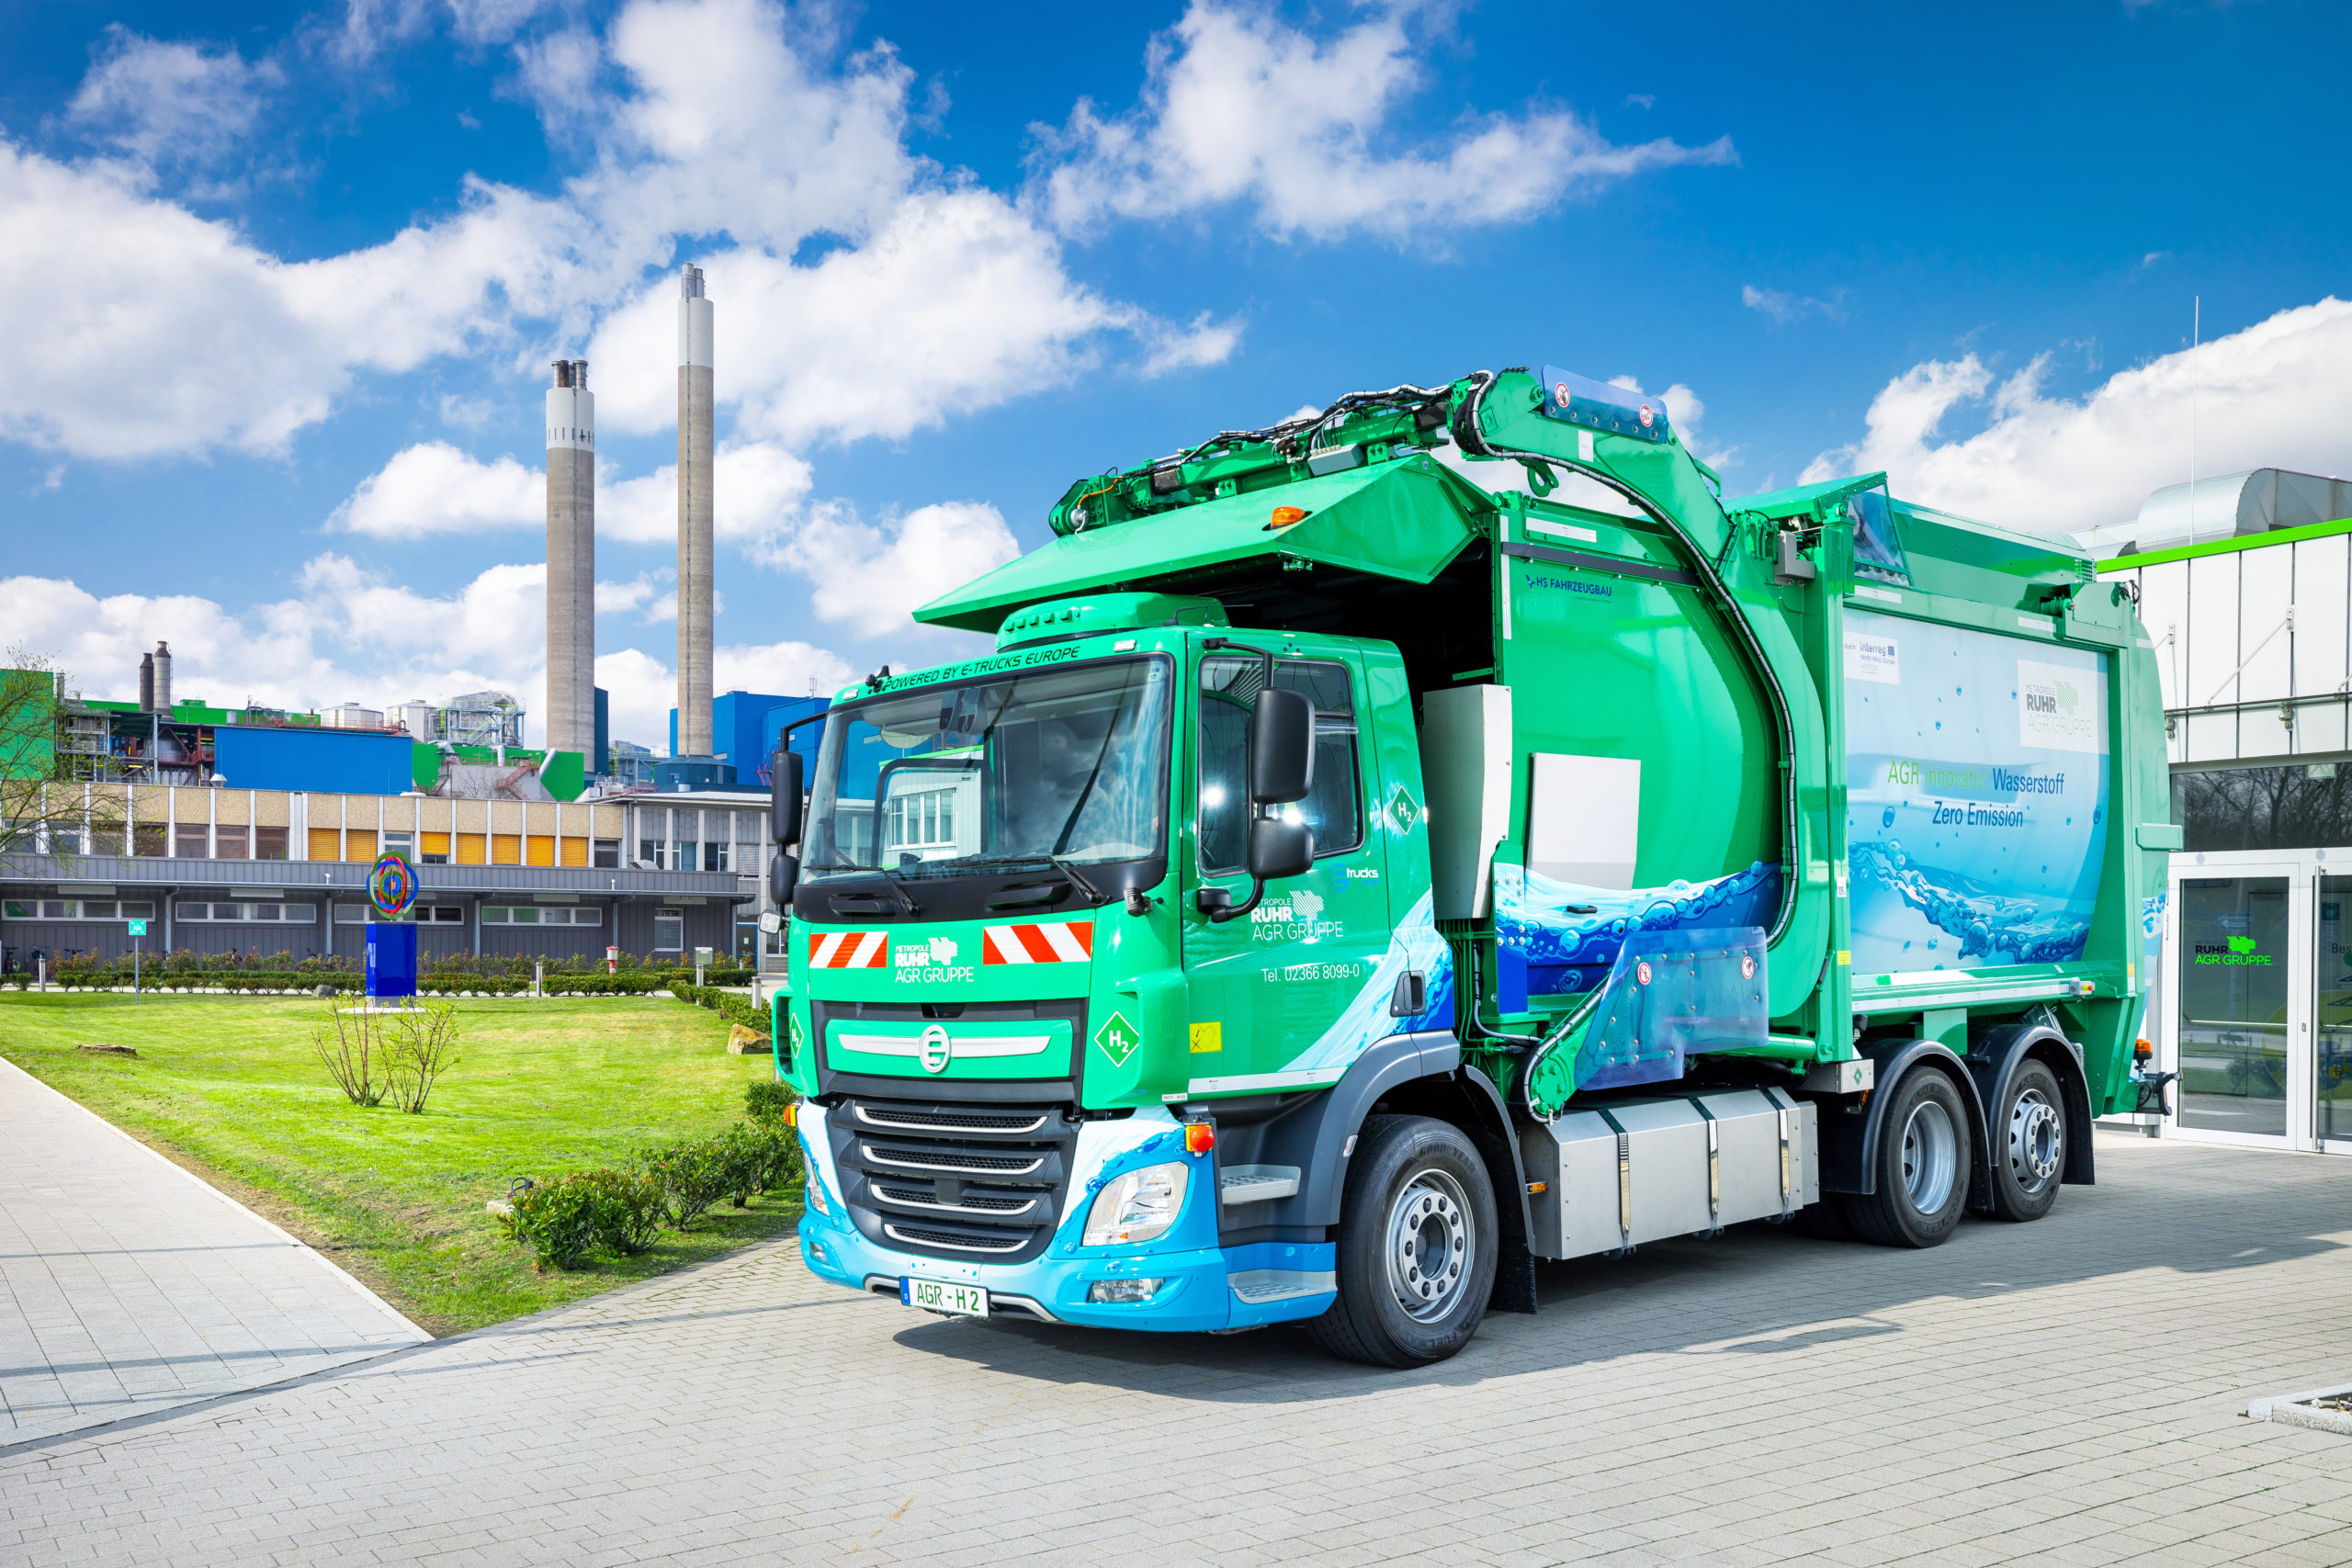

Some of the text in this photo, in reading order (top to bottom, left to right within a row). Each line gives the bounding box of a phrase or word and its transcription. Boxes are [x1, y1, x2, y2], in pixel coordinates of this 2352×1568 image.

[1536, 576, 1612, 596] HS FAHRZEUGBAU
[1860, 640, 1886, 656] Interreg
[883, 646, 1080, 692] POWERED BY E-TRUCKS EUROPE
[2027, 694, 2057, 714] RUHR
[2028, 713, 2093, 738] AGR GRUPPE
[1887, 760, 2065, 795] AGR innovativ: Wasserstoff
[1932, 800, 2024, 828] Zero Emission
[1347, 867, 1379, 878] trucks
[1257, 897, 1291, 906] TROPOLE
[1250, 906, 1294, 923] RUHR
[1252, 921, 1344, 941] AGR GRUPPE
[895, 944, 930, 953] METROPOLE
[2195, 945, 2229, 954] RUHR
[895, 952, 930, 967] RUHR
[2195, 954, 2272, 966] AGR GRUPPE
[895, 965, 975, 983] AGR GRUPPE
[1261, 964, 1360, 982] Tel. 02366 8099-0
[917, 1283, 944, 1306] AGR
